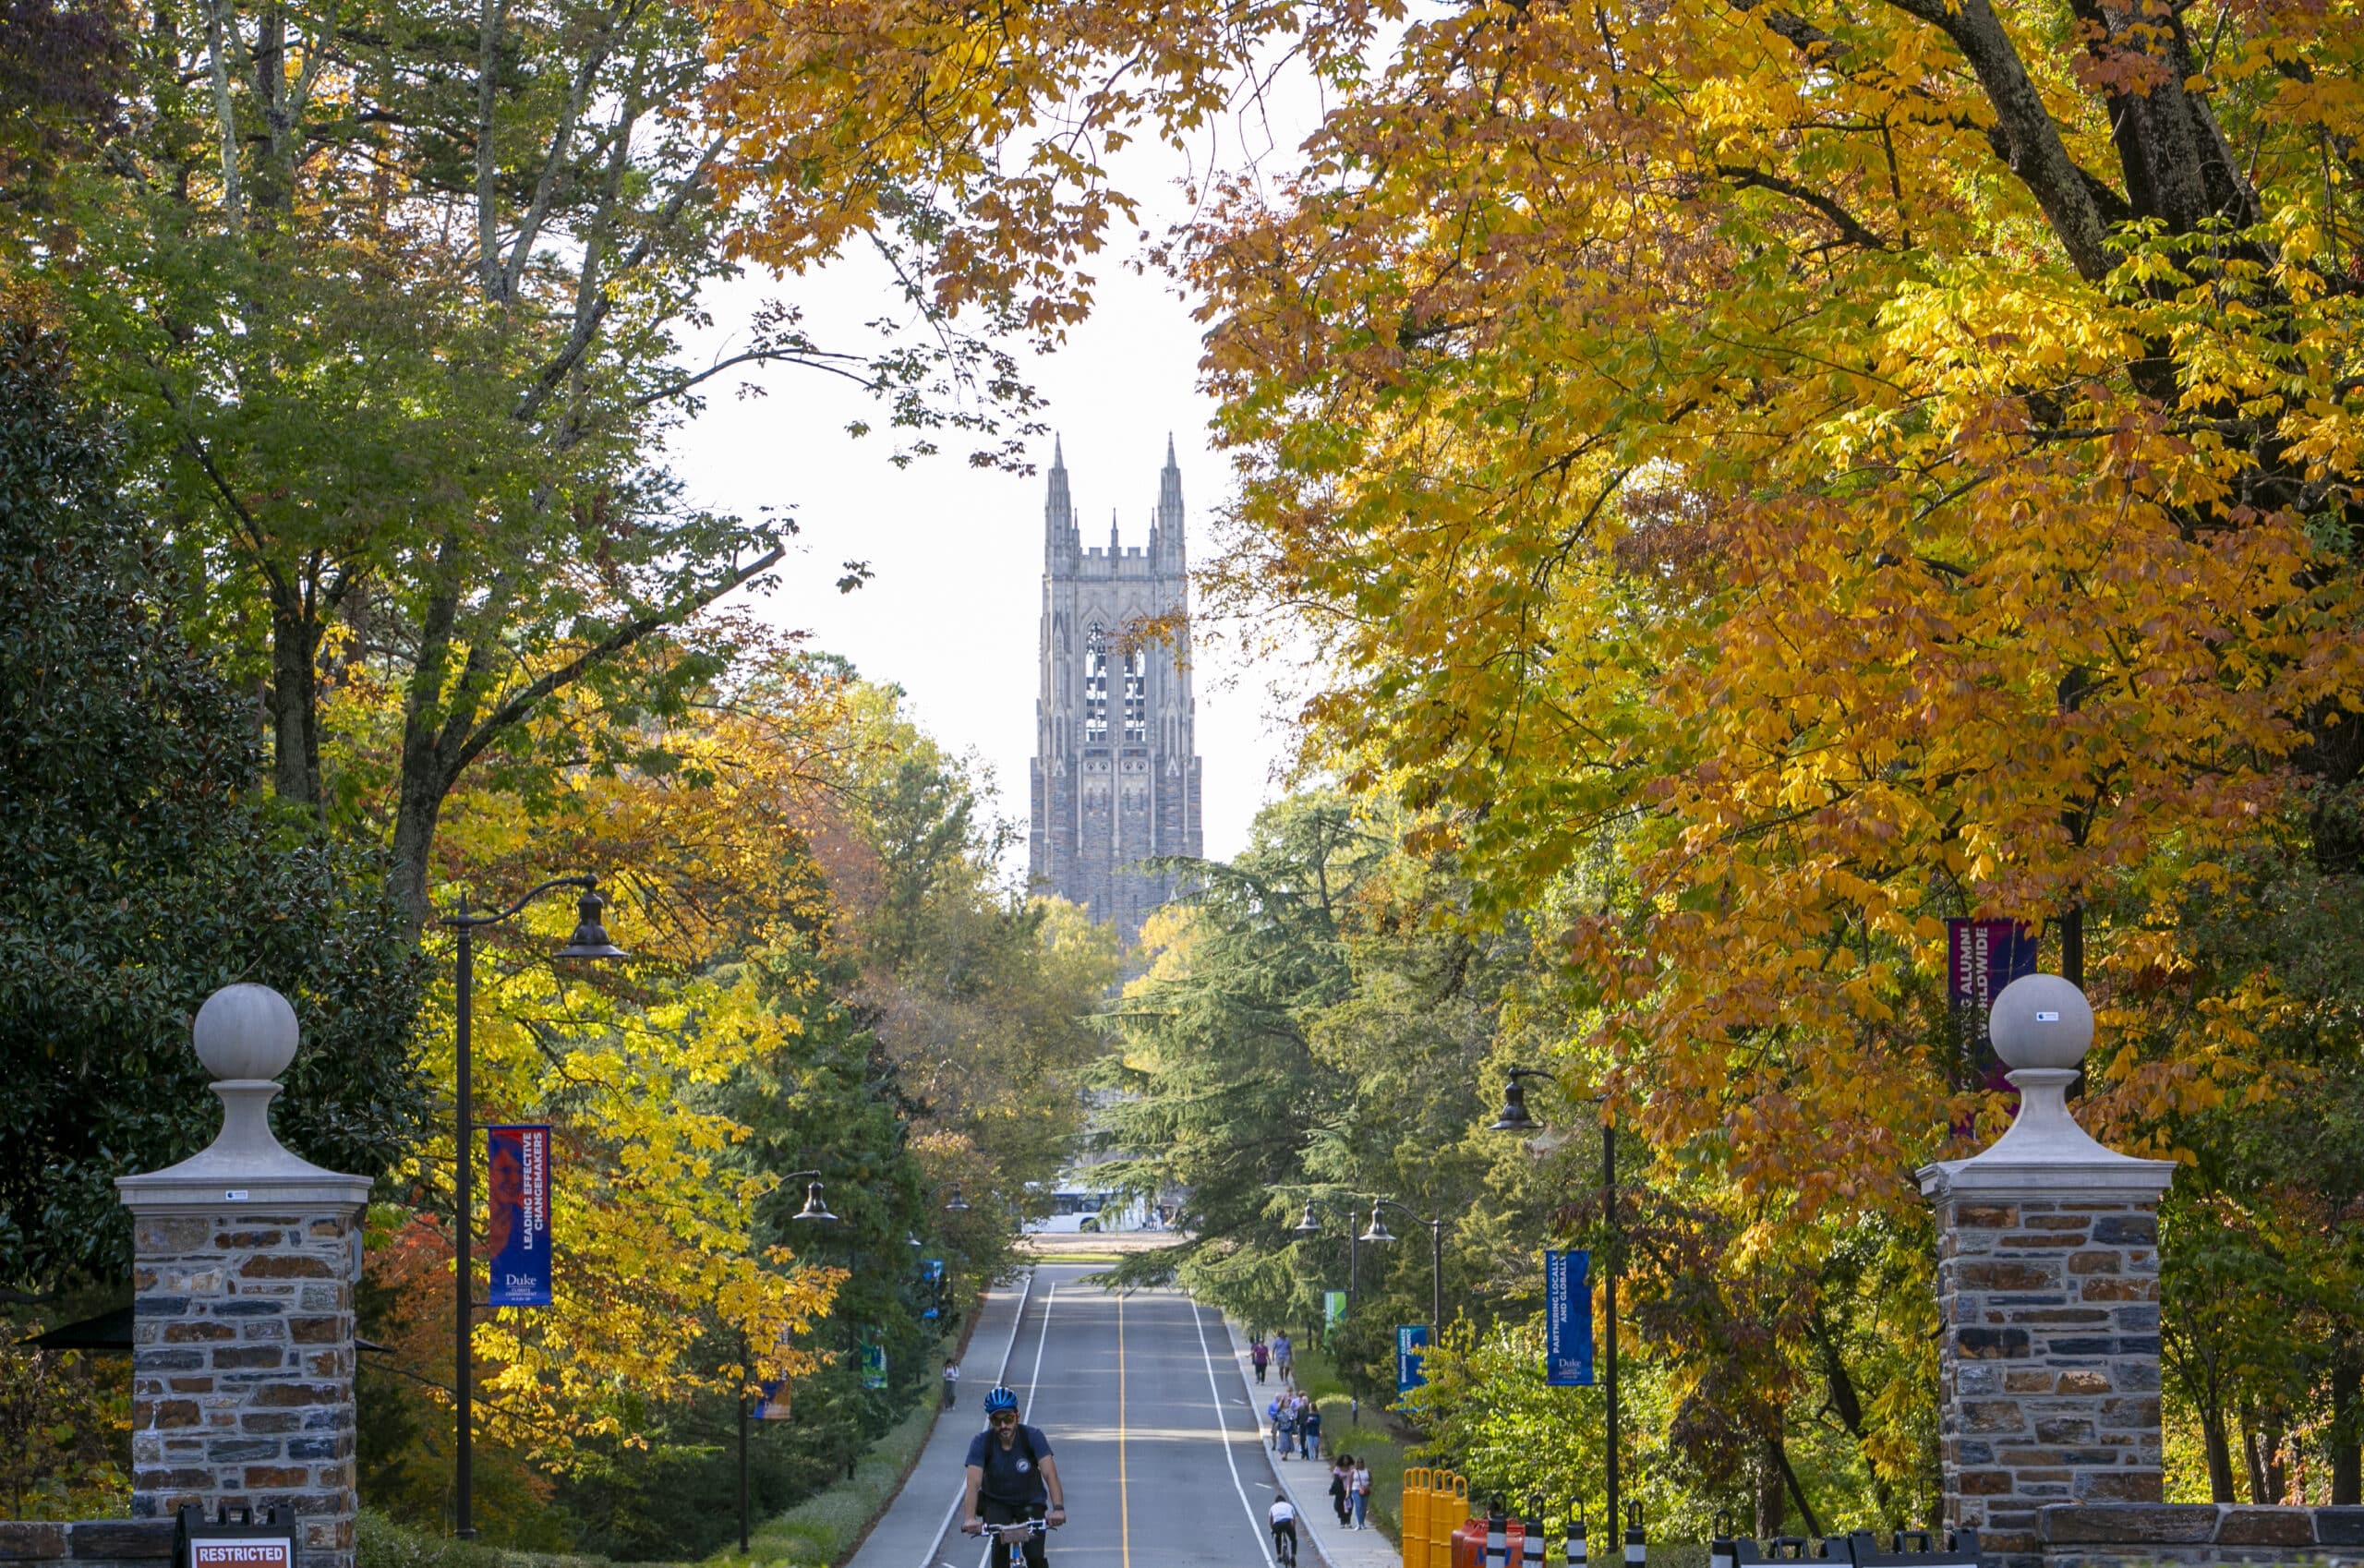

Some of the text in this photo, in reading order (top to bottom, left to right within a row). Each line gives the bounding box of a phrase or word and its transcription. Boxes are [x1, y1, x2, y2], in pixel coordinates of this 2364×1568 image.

[1960, 927, 1972, 995] ALUMNI
[523, 1132, 533, 1250] LEADING EFFECTIVE
[533, 1132, 543, 1231] CHANGEMAKERS
[506, 1273, 537, 1285] Duke
[1559, 1357, 1582, 1367] Duke
[199, 1547, 283, 1562] RESTRICTED
